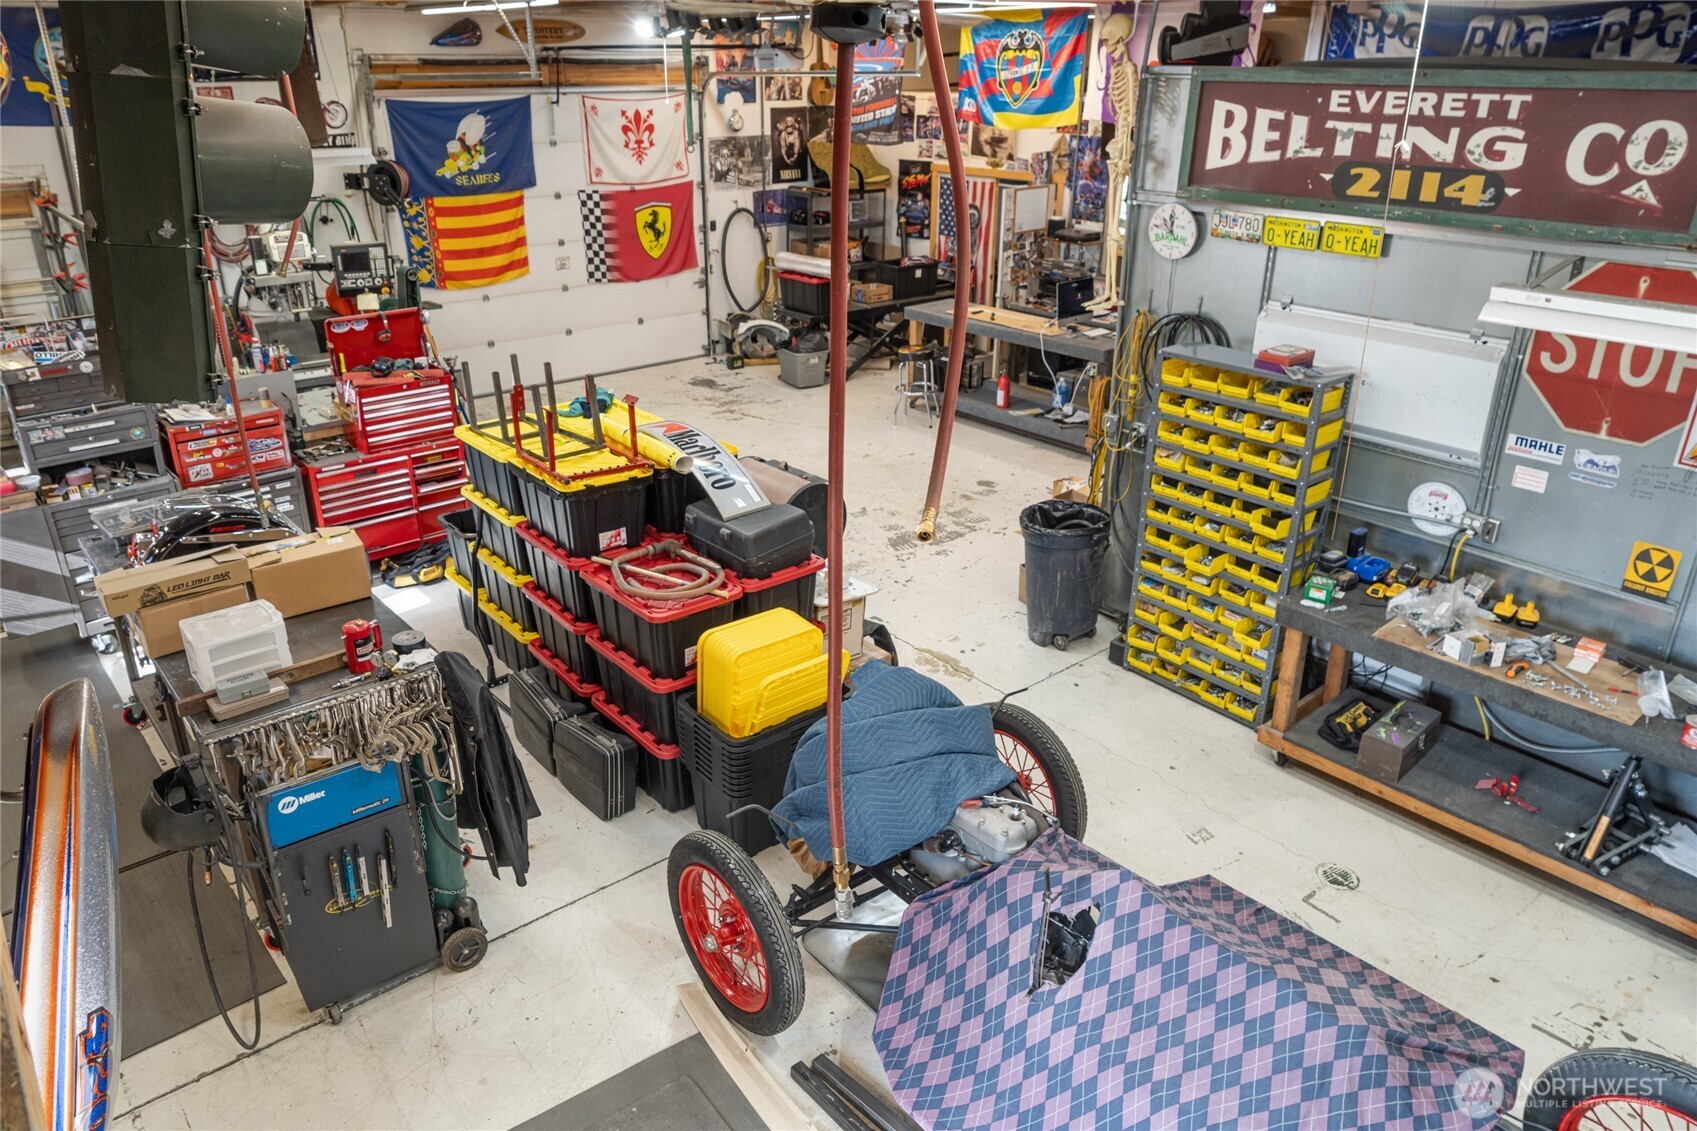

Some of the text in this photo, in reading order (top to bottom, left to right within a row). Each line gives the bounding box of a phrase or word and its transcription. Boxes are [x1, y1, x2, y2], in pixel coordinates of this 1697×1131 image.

[1469, 14, 1547, 57] PPG
[1596, 4, 1686, 58] PPG
[1328, 89, 1533, 121] EVERETT
[1204, 98, 1529, 171] BELTING
[1565, 119, 1689, 187] CO
[455, 172, 500, 186] SEABEES
[1346, 166, 1488, 208] 2114
[1155, 231, 1188, 247] BARDAHL
[1240, 215, 1260, 233] 780
[663, 429, 737, 490] Marlboro
[1515, 436, 1565, 456] MAHLE
[166, 583, 185, 593] LED
[185, 575, 211, 588] LIGHT
[212, 571, 232, 581] BAR
[298, 790, 327, 805] Miller
